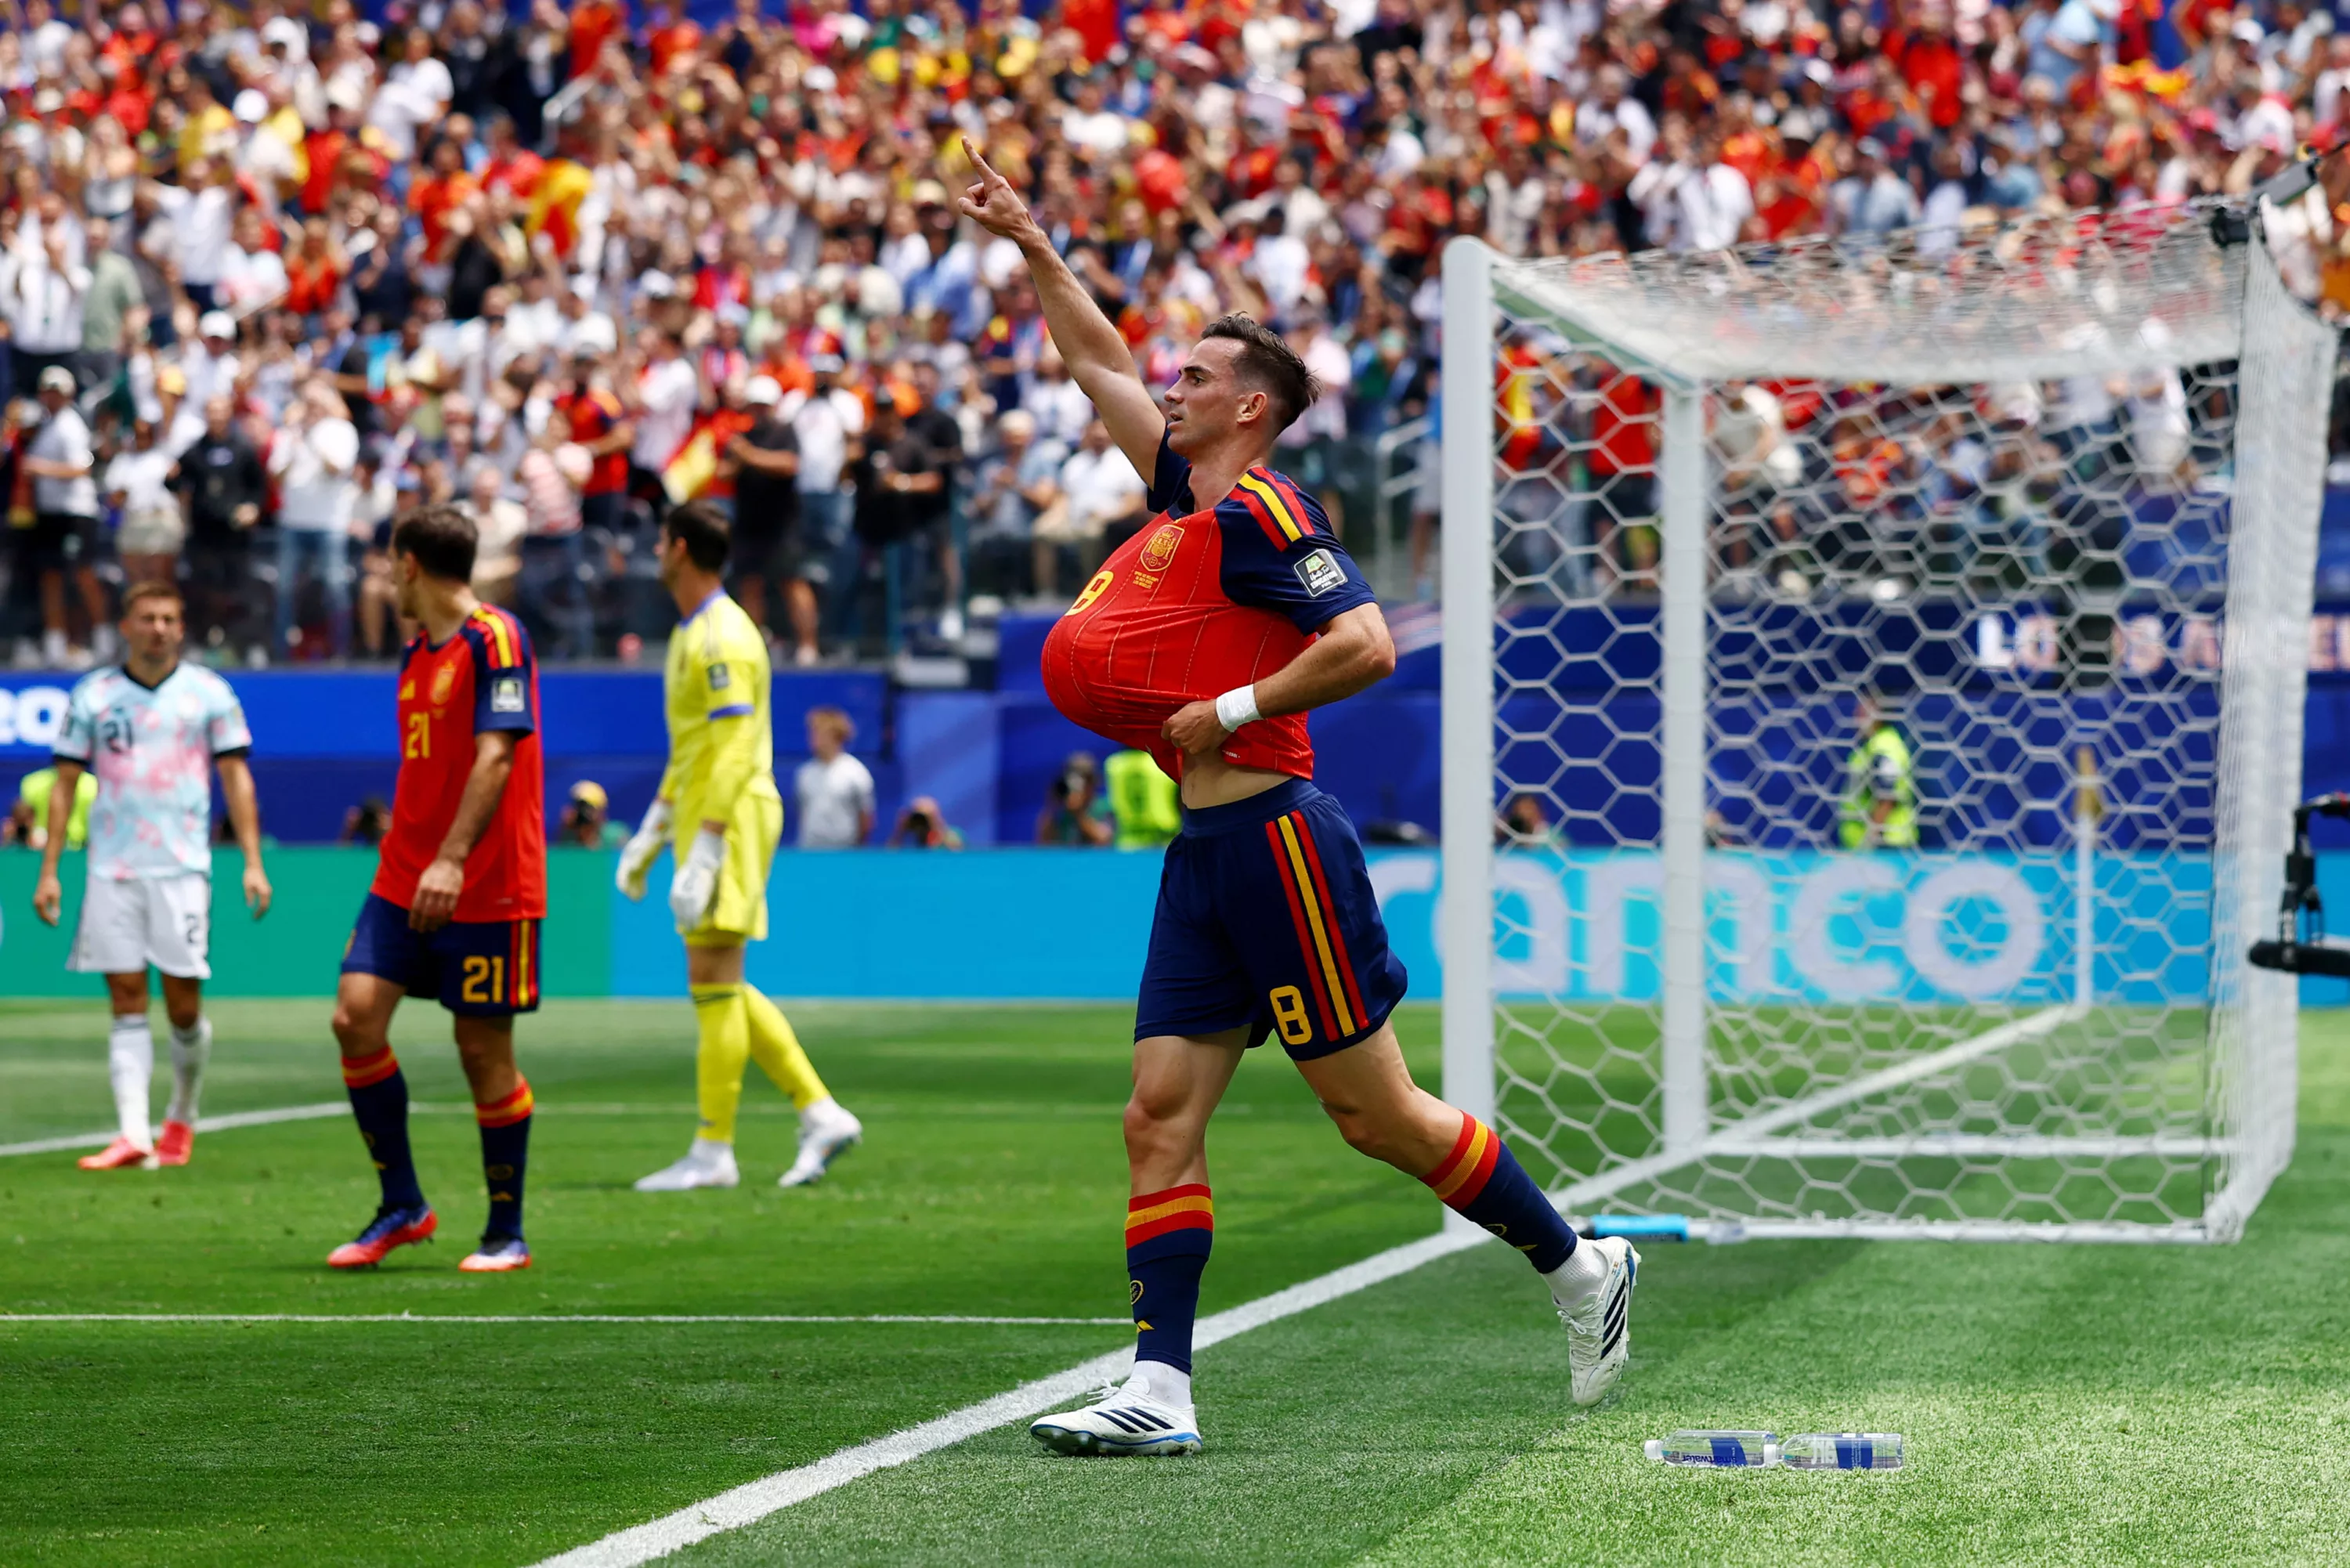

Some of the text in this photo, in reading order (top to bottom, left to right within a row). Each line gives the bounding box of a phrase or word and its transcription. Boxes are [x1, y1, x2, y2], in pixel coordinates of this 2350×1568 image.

[102, 719, 134, 754] 21
[405, 711, 429, 760] 21
[461, 955, 504, 1003] 21
[1269, 985, 1313, 1046] 8
